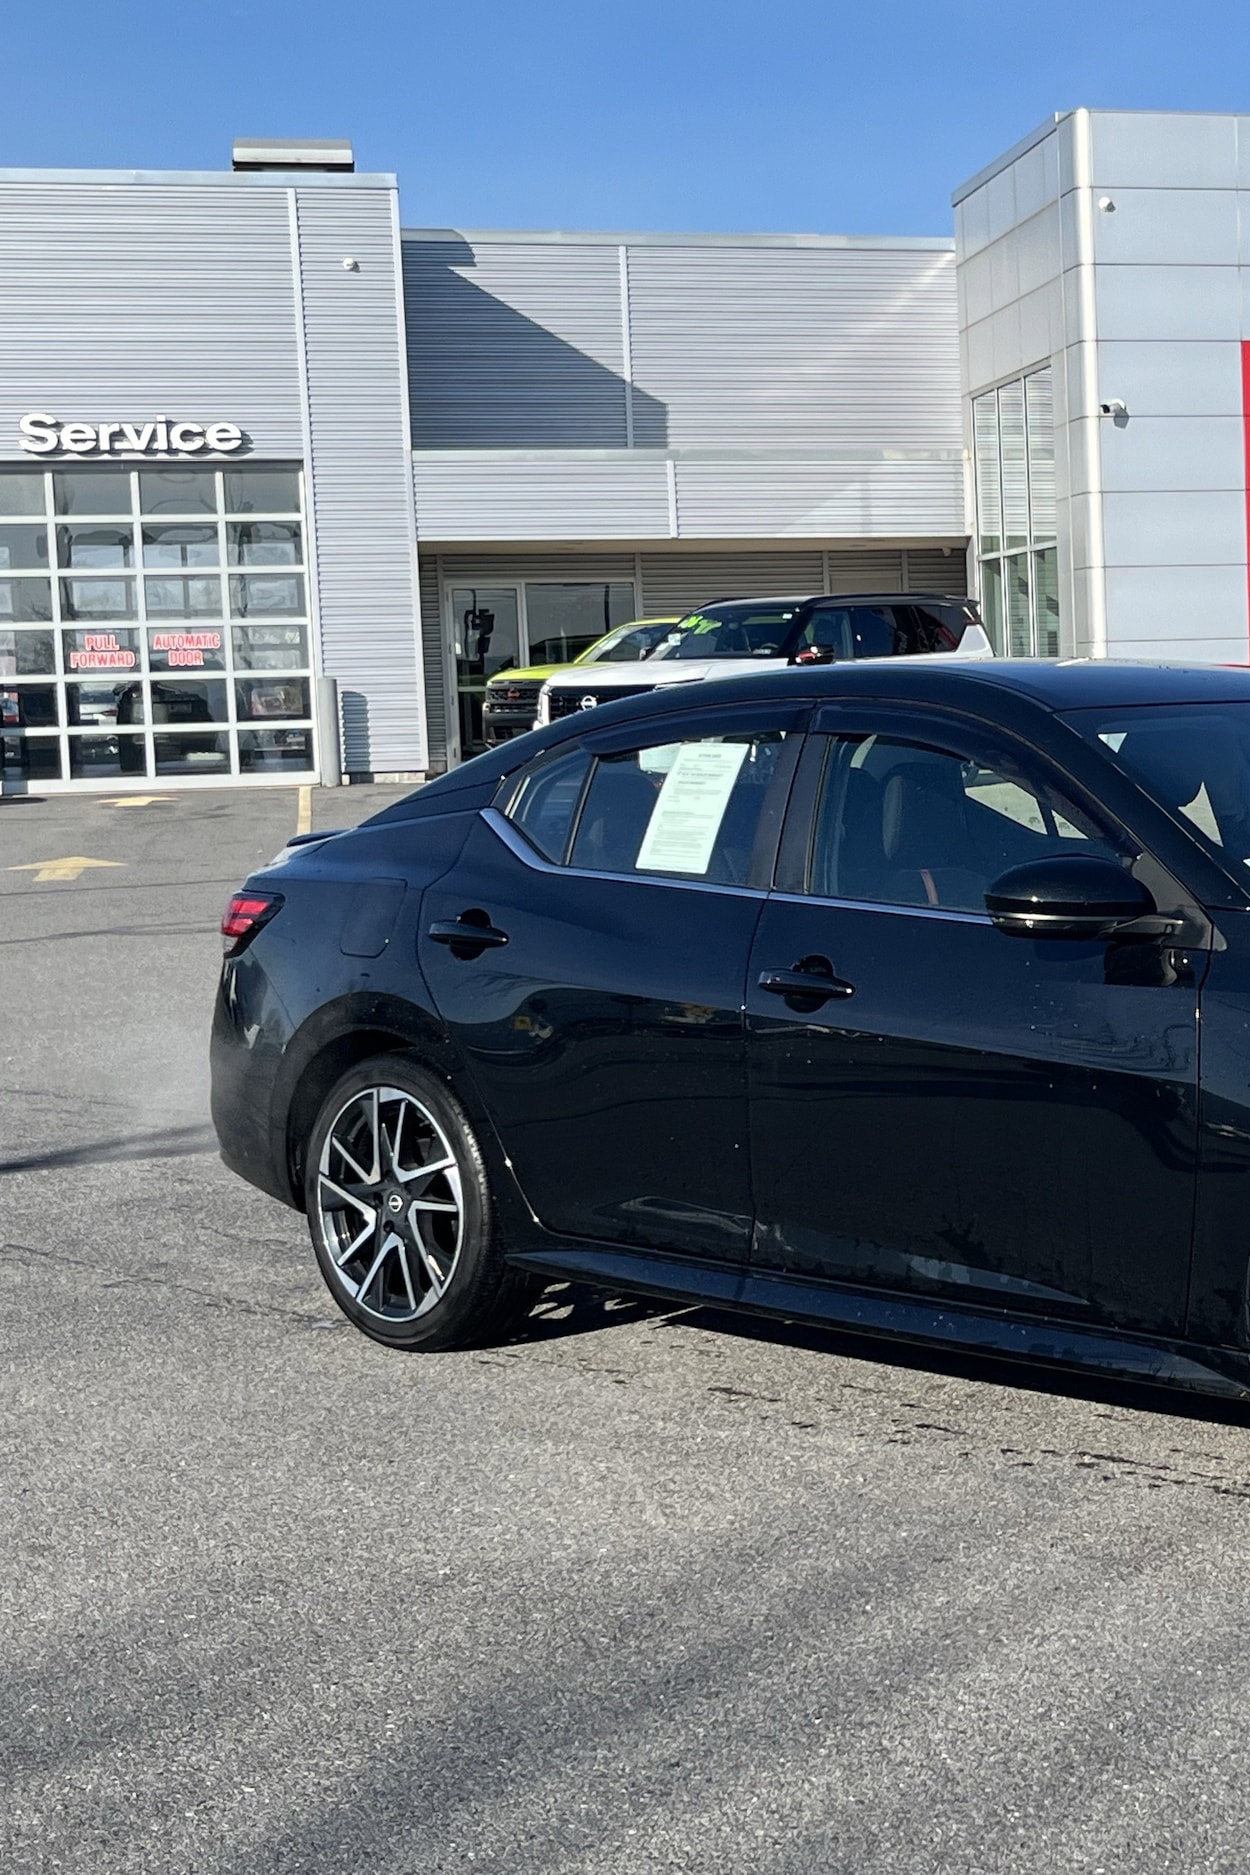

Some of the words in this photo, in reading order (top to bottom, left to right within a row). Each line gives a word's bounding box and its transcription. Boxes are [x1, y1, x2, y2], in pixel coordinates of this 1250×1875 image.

[19, 413, 242, 452] Service
[85, 634, 120, 651] PULL
[153, 632, 221, 650] AUTOMATIC
[70, 651, 136, 669] FORWARD
[167, 650, 205, 666] DOOR
